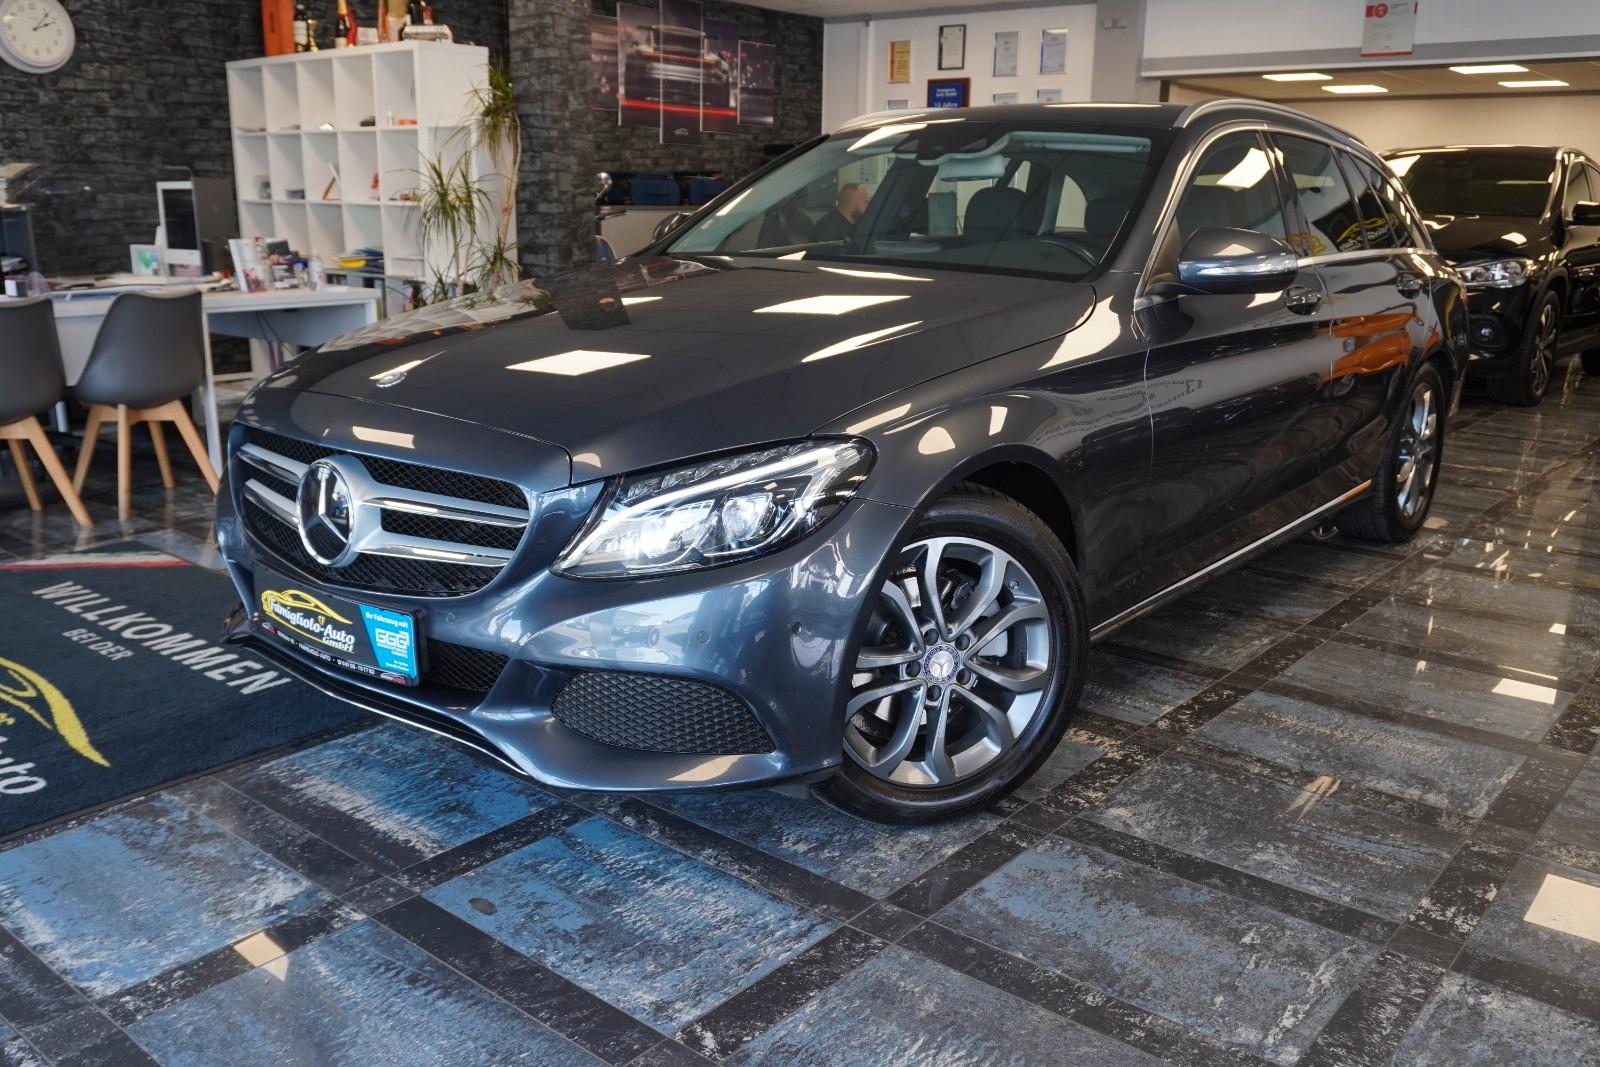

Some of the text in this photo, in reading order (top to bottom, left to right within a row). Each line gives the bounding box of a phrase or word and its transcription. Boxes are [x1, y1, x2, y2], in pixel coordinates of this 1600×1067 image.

[32, 581, 292, 695] WILLKOMMEN
[62, 628, 135, 661] BEI DER
[270, 597, 355, 646] Famigliolo-Auto
[322, 636, 354, 653] GmbH
[0, 736, 47, 795] to
